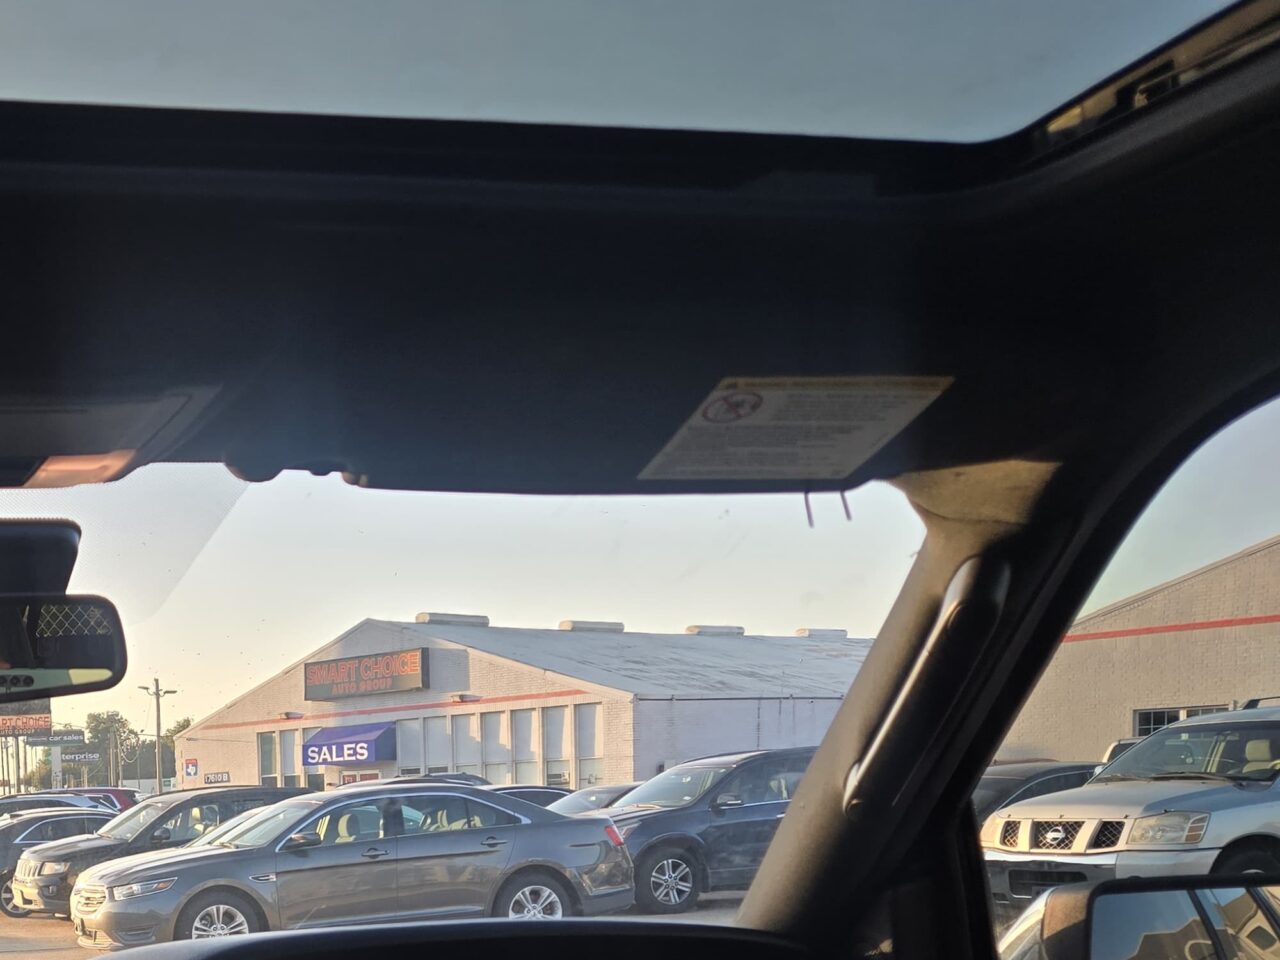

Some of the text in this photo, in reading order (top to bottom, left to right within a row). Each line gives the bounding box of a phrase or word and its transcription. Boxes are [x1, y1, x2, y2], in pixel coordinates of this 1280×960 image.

[307, 652, 420, 685] SMART CHOICE
[331, 678, 393, 695] AUTO GROUP
[15, 716, 49, 729] CHOICE
[307, 742, 369, 763] SALES
